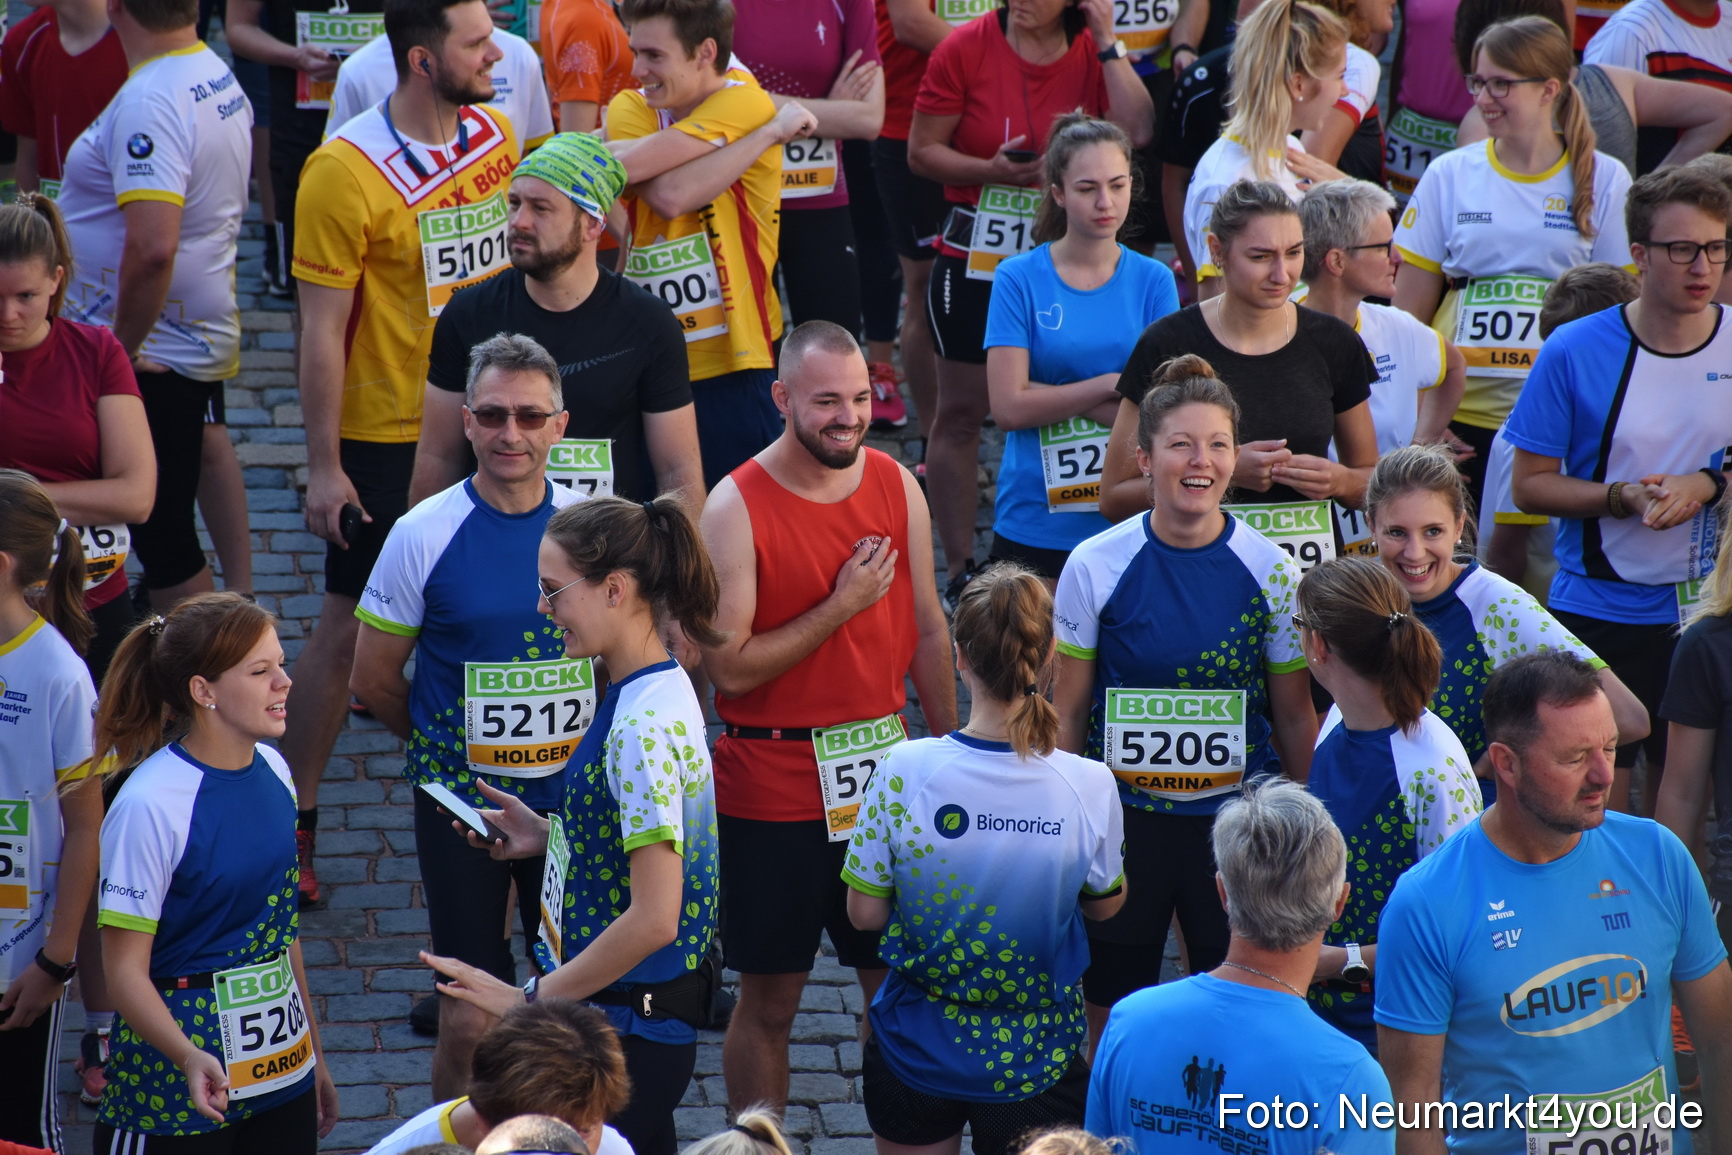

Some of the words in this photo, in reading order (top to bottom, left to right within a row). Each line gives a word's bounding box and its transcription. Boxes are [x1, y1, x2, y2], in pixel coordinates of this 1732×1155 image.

[309, 21, 385, 37] BOCK
[190, 84, 211, 102] 20.
[785, 136, 824, 163] 62
[127, 163, 155, 172] PARTL
[472, 153, 520, 196] BÖGL
[782, 172, 819, 186] ALIE
[1545, 198, 1567, 211] 20
[430, 201, 507, 236] BOCK
[984, 218, 1036, 251] 51
[437, 230, 506, 278] 5101
[642, 273, 707, 309] 00
[1490, 352, 1531, 366] LISA
[549, 447, 597, 465] CK
[1057, 442, 1108, 479] 52
[479, 665, 580, 690] BOCK
[6, 691, 27, 701] JAHRE
[585, 698, 591, 706] S
[1119, 697, 1228, 717] BOCK
[482, 698, 582, 739] 5212
[825, 716, 900, 753] BOCK
[494, 744, 570, 764] HOLGER
[1121, 730, 1230, 767] 5206
[835, 756, 884, 799] 52
[1135, 776, 1213, 790] CARINA
[17, 845, 23, 853] S
[1488, 910, 1516, 921] erima
[1601, 911, 1632, 931] TUM
[10, 912, 45, 947] September
[1491, 927, 1523, 951] BLV
[1503, 969, 1647, 1020] LAUF10!
[239, 991, 304, 1053] 5208
[252, 1041, 308, 1079] CAROLIN
[1130, 1098, 1148, 1112] SC
